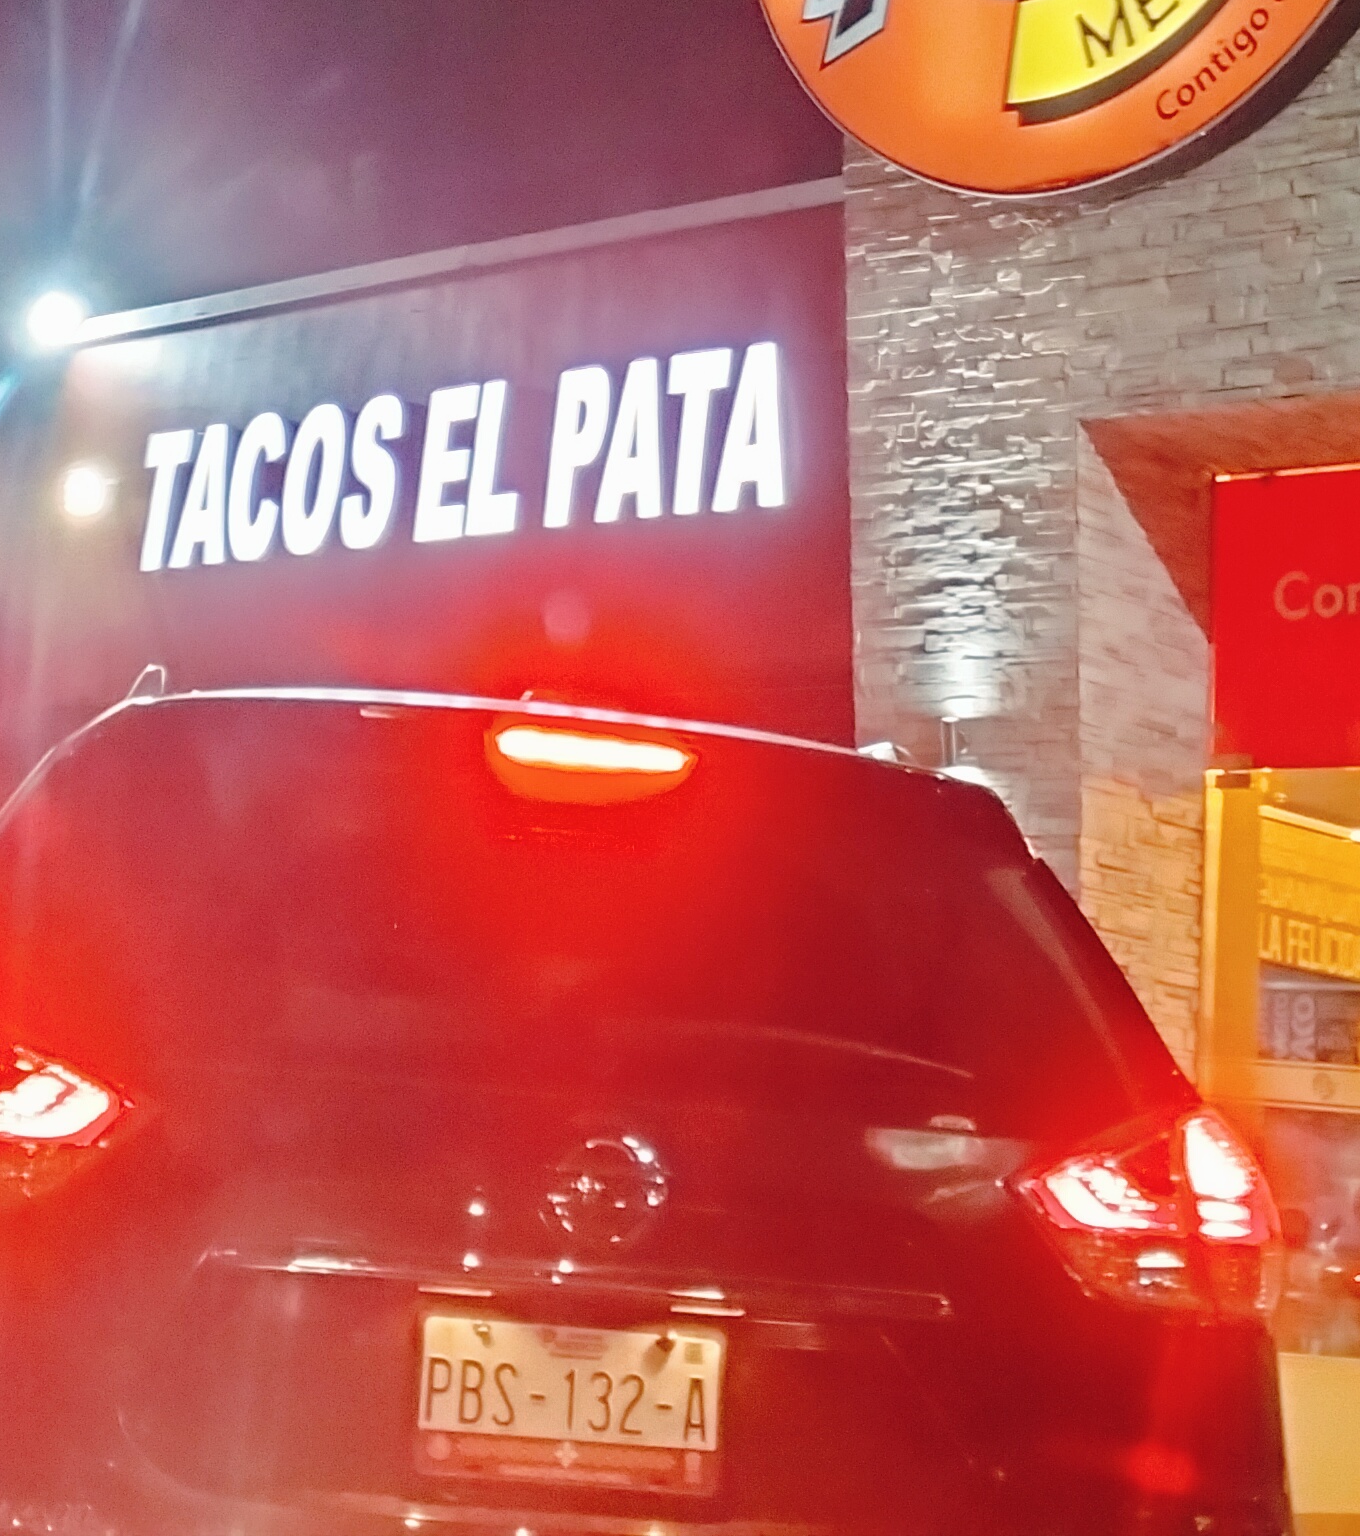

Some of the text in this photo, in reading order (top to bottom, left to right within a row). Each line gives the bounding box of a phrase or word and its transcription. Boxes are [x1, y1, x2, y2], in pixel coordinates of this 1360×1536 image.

[1155, 6, 1270, 121] Contigo
[139, 341, 786, 572] TACOS EL PATA
[424, 1356, 707, 1444] PBS-132-A
